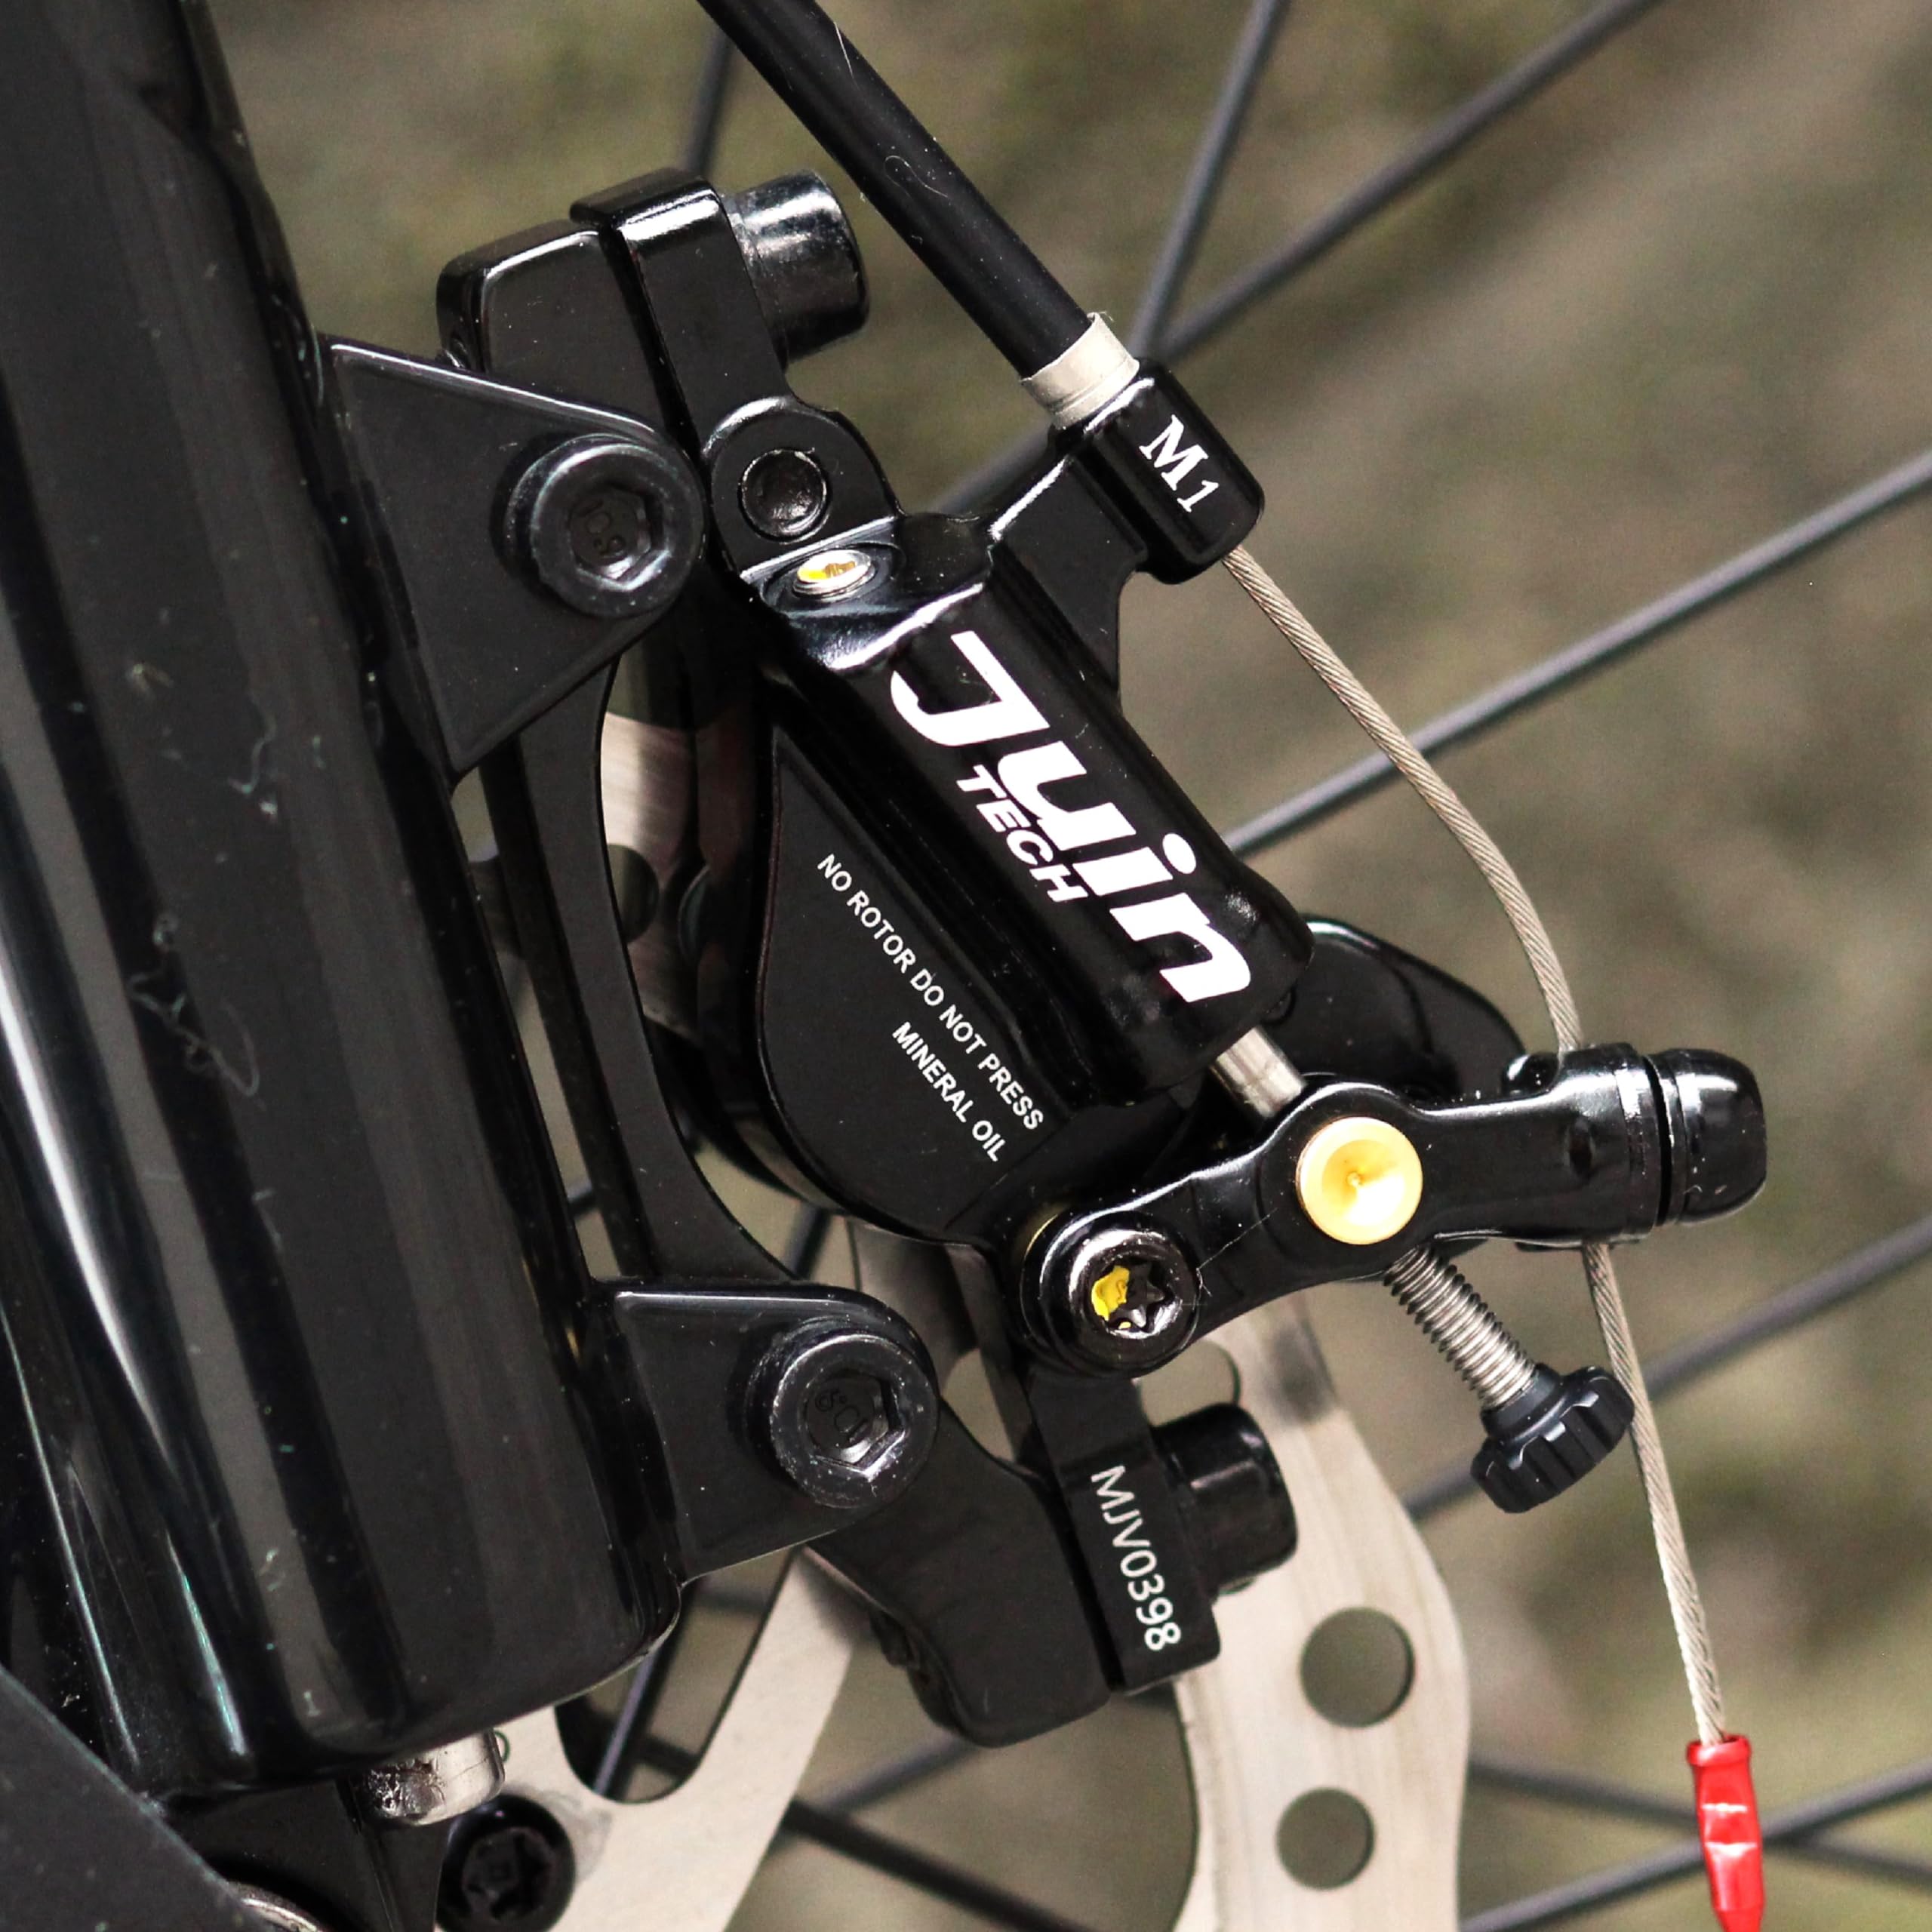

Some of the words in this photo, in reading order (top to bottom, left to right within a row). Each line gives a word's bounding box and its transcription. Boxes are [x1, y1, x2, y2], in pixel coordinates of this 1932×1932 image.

[1138, 414, 1220, 513] M1
[890, 630, 1251, 1003] Juin
[956, 764, 1088, 903] TECH
[817, 854, 853, 892] NO
[846, 890, 916, 974] ROTOR
[909, 968, 945, 1007] DO
[938, 1004, 987, 1054] NOT
[977, 1053, 1044, 1130] PRESS
[891, 1021, 974, 1123] MINERAL
[971, 1120, 1006, 1162] OIL
[1091, 1465, 1182, 1651] MJV0398
